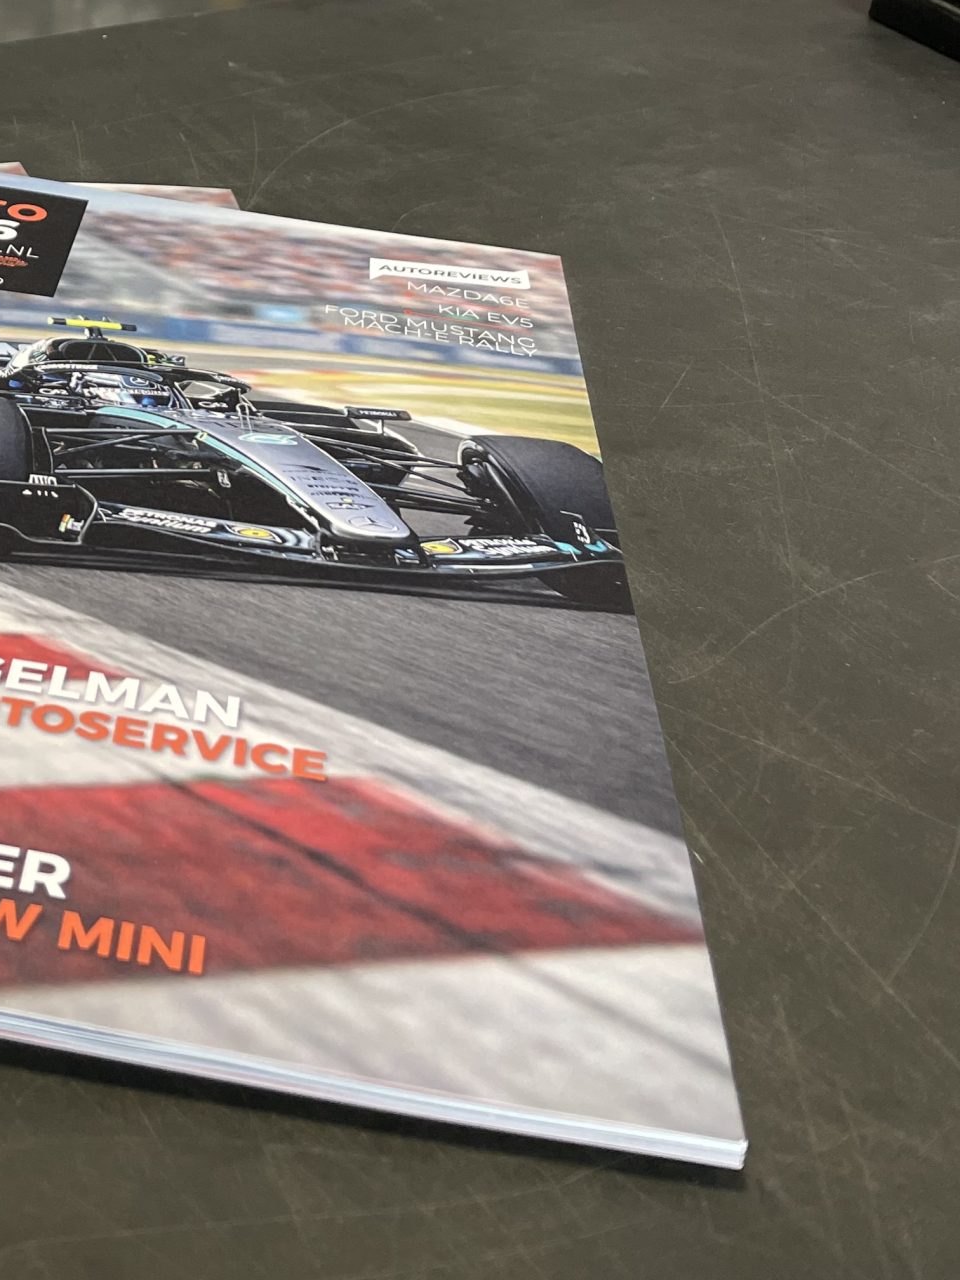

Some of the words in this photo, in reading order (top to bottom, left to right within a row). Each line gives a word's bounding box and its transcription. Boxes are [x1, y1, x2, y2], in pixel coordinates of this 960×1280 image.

[379, 264, 522, 285] AUTOREVIEWS
[324, 305, 398, 324] FORD
[406, 318, 536, 348] MUSTANG
[439, 304, 479, 319] KIA
[487, 312, 534, 329] EV5
[344, 318, 450, 343] MACH-E
[459, 336, 538, 358] RALLY
[58, 909, 207, 975] MINI
